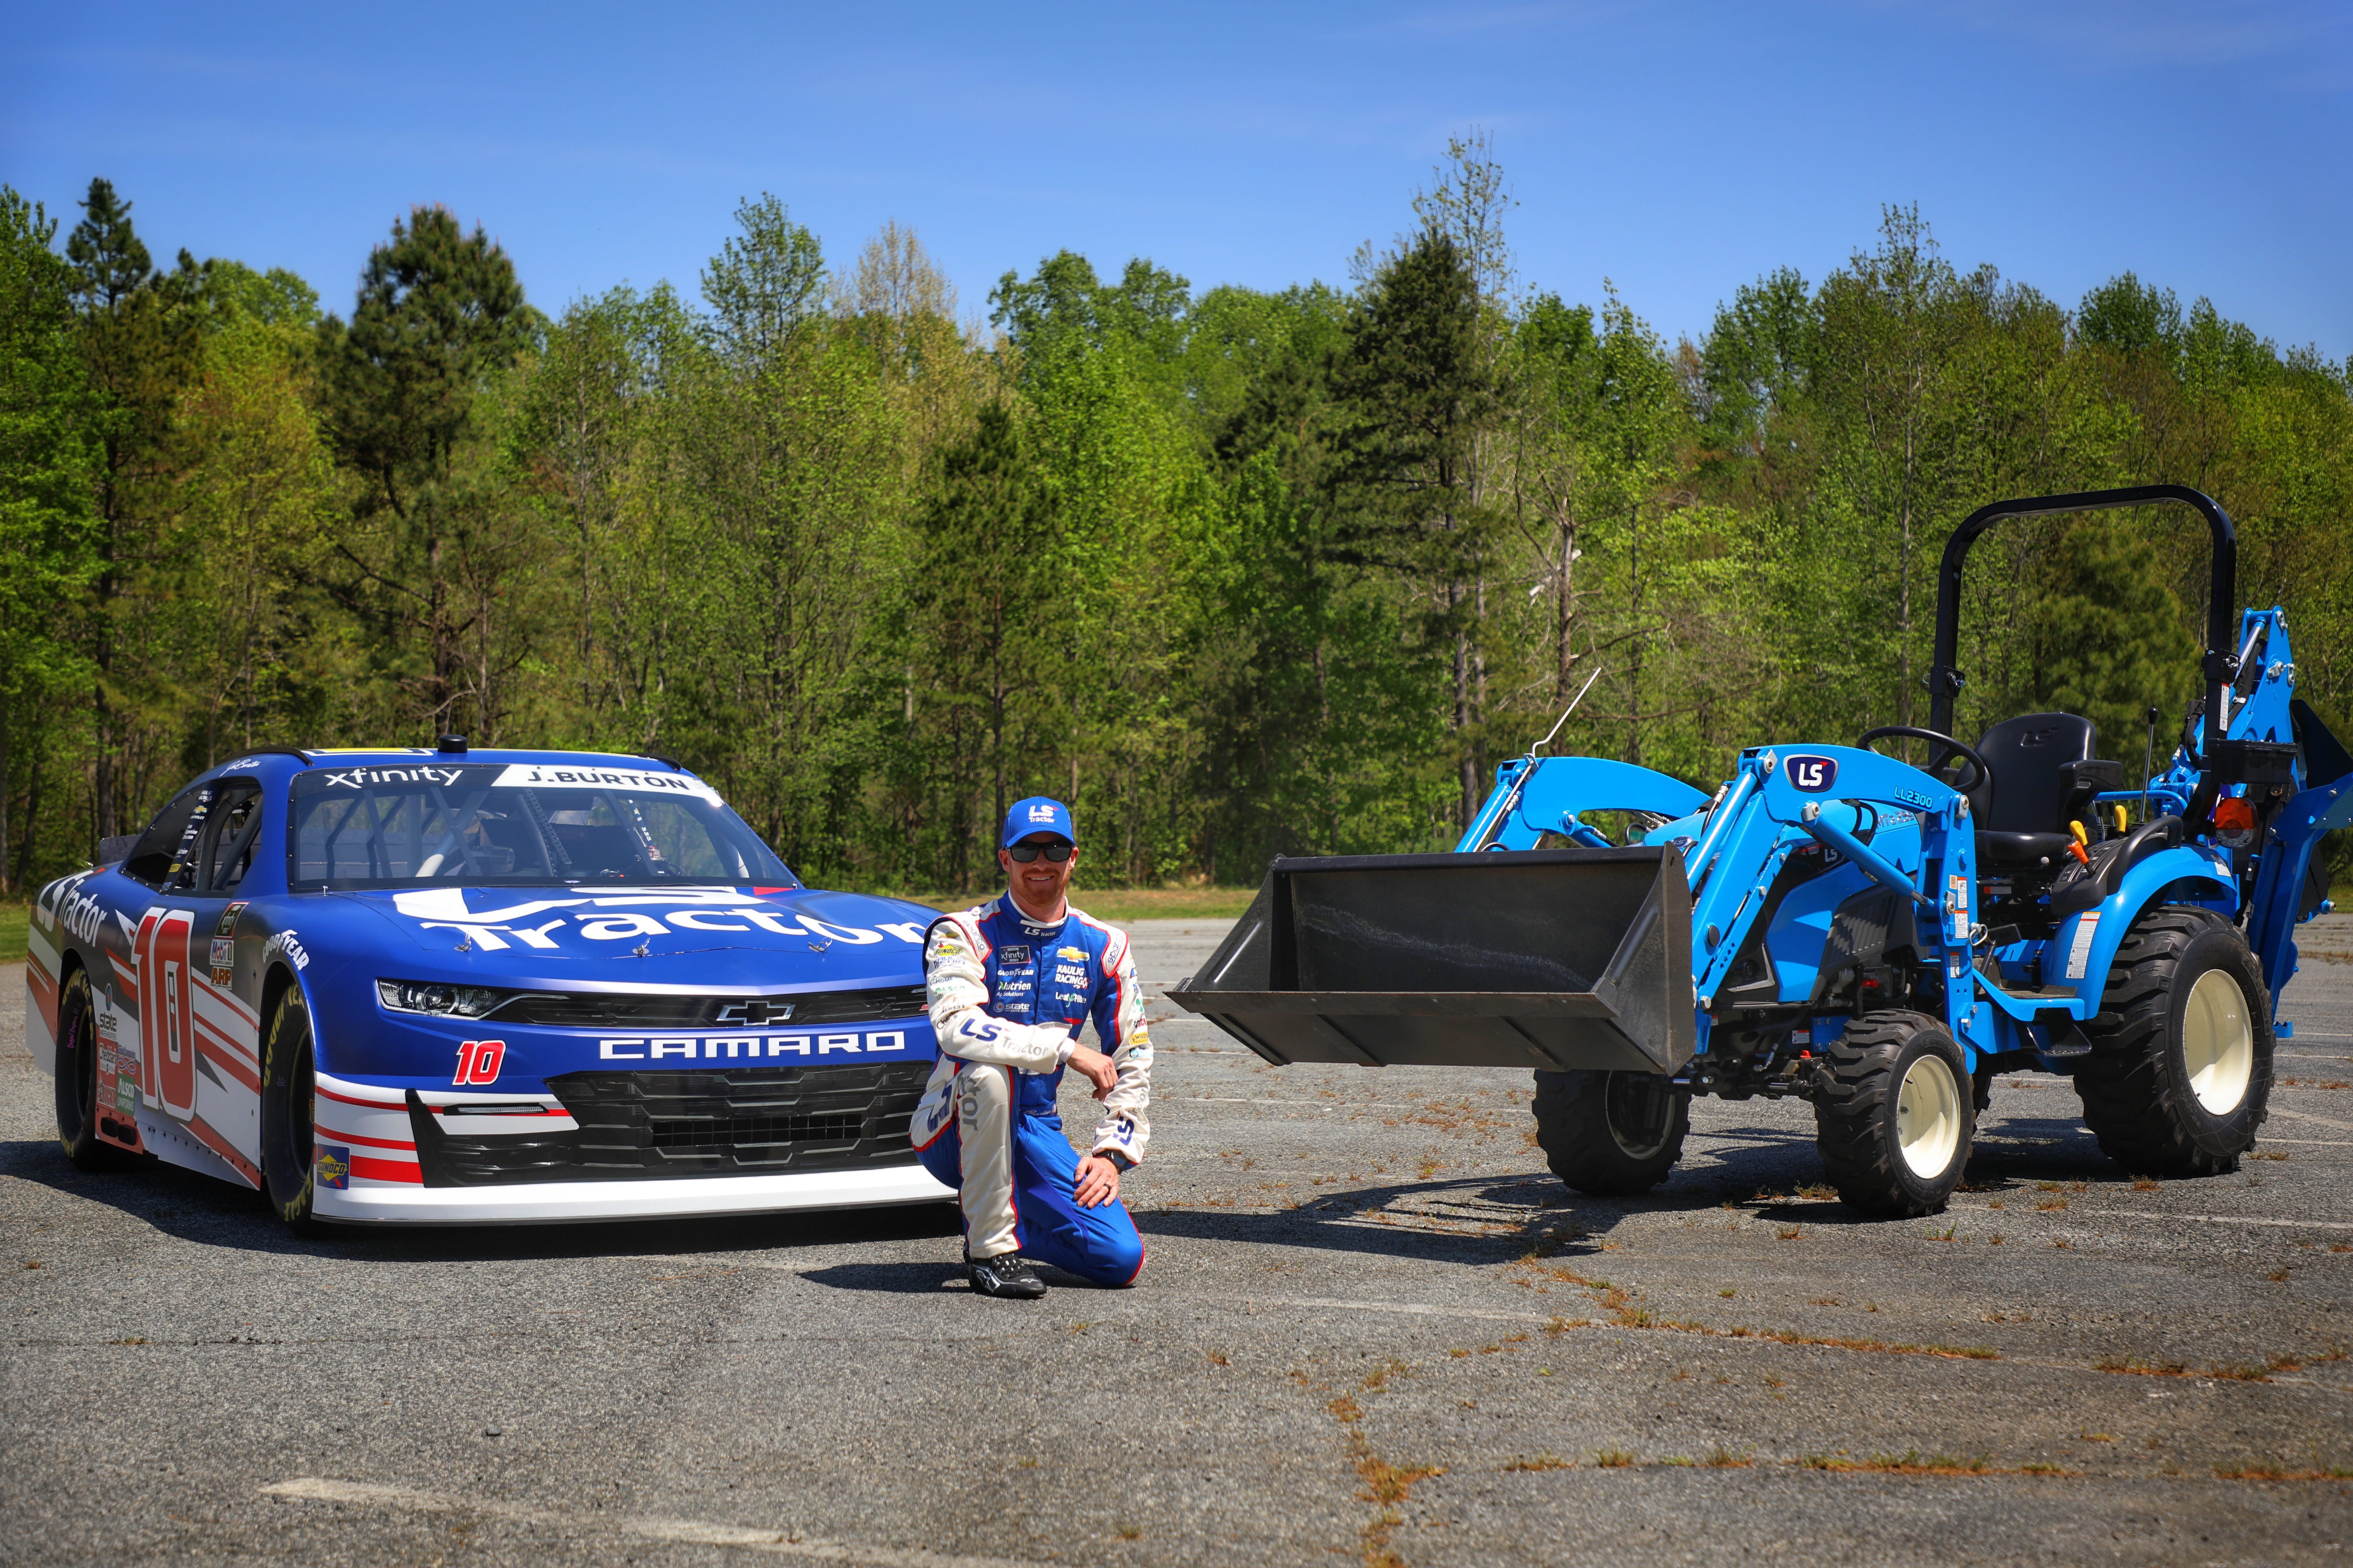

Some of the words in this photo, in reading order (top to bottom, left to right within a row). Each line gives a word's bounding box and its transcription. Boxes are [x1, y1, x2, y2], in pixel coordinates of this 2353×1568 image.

[324, 766, 463, 789] xfinity
[528, 771, 690, 790] J.BURTON
[1799, 763, 1822, 786] LS
[1895, 785, 1933, 809] LL2300
[1029, 805, 1054, 817] LS
[1825, 848, 1837, 862] LS
[59, 878, 108, 948] Tractor
[421, 908, 927, 952] Tractor
[1025, 927, 1040, 936] LS
[212, 940, 228, 961] Mobil
[263, 929, 309, 971] GOODYEAR
[1001, 951, 1024, 961] xfinity
[211, 967, 231, 986] ARP
[997, 968, 1034, 977] GOODYEAR
[1055, 973, 1084, 985] RACING
[1057, 964, 1085, 976] KAULIG
[999, 980, 1031, 990] Nutrien
[100, 1012, 117, 1032] state
[131, 907, 197, 1122] 10
[600, 1031, 904, 1059] CAMARO
[960, 1018, 1002, 1042] LS
[1002, 1036, 1049, 1056] Tractor
[452, 1039, 506, 1086] 10
[118, 1078, 134, 1098] ALSCO
[117, 1096, 134, 1111] UNIFORMS
[318, 1159, 346, 1175] SUNOCO
